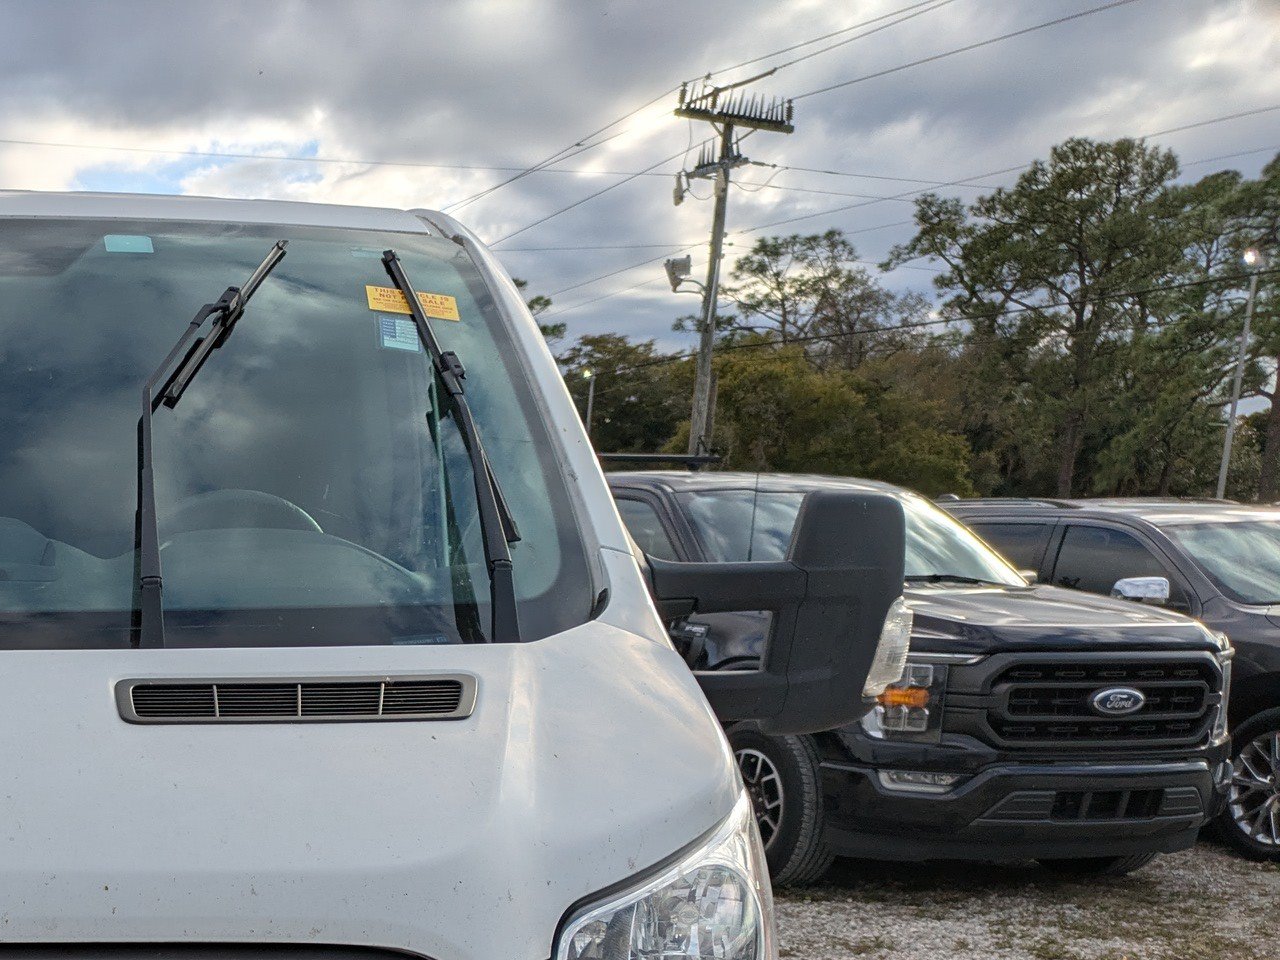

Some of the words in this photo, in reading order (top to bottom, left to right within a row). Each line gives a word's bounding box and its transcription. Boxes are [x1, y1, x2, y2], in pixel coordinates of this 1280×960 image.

[374, 287, 396, 295] THIS
[422, 298, 445, 306] SALE
[1107, 694, 1134, 708] Ford
